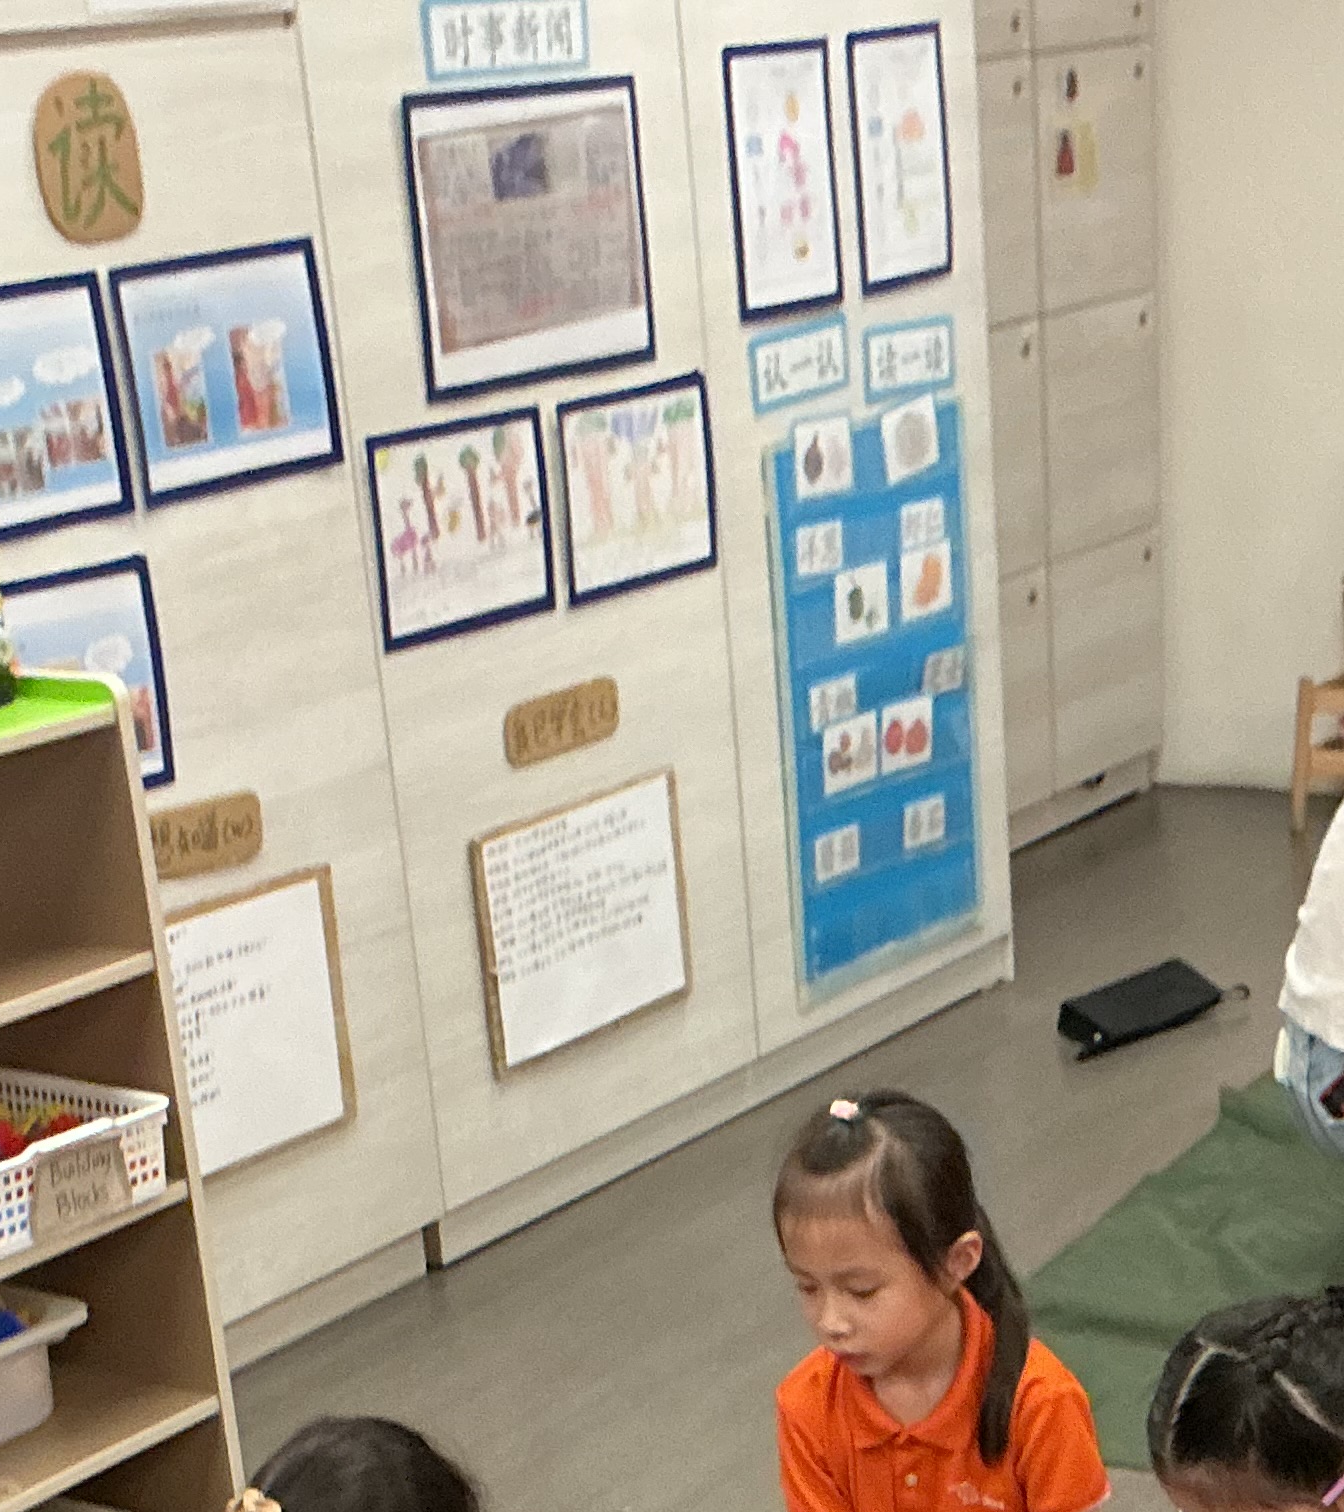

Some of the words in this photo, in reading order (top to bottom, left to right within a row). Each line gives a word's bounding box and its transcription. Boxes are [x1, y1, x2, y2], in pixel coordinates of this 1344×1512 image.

[443, 6, 574, 67] 时事新闻
[49, 1150, 112, 1188] Building
[56, 1181, 109, 1218] Blocks
